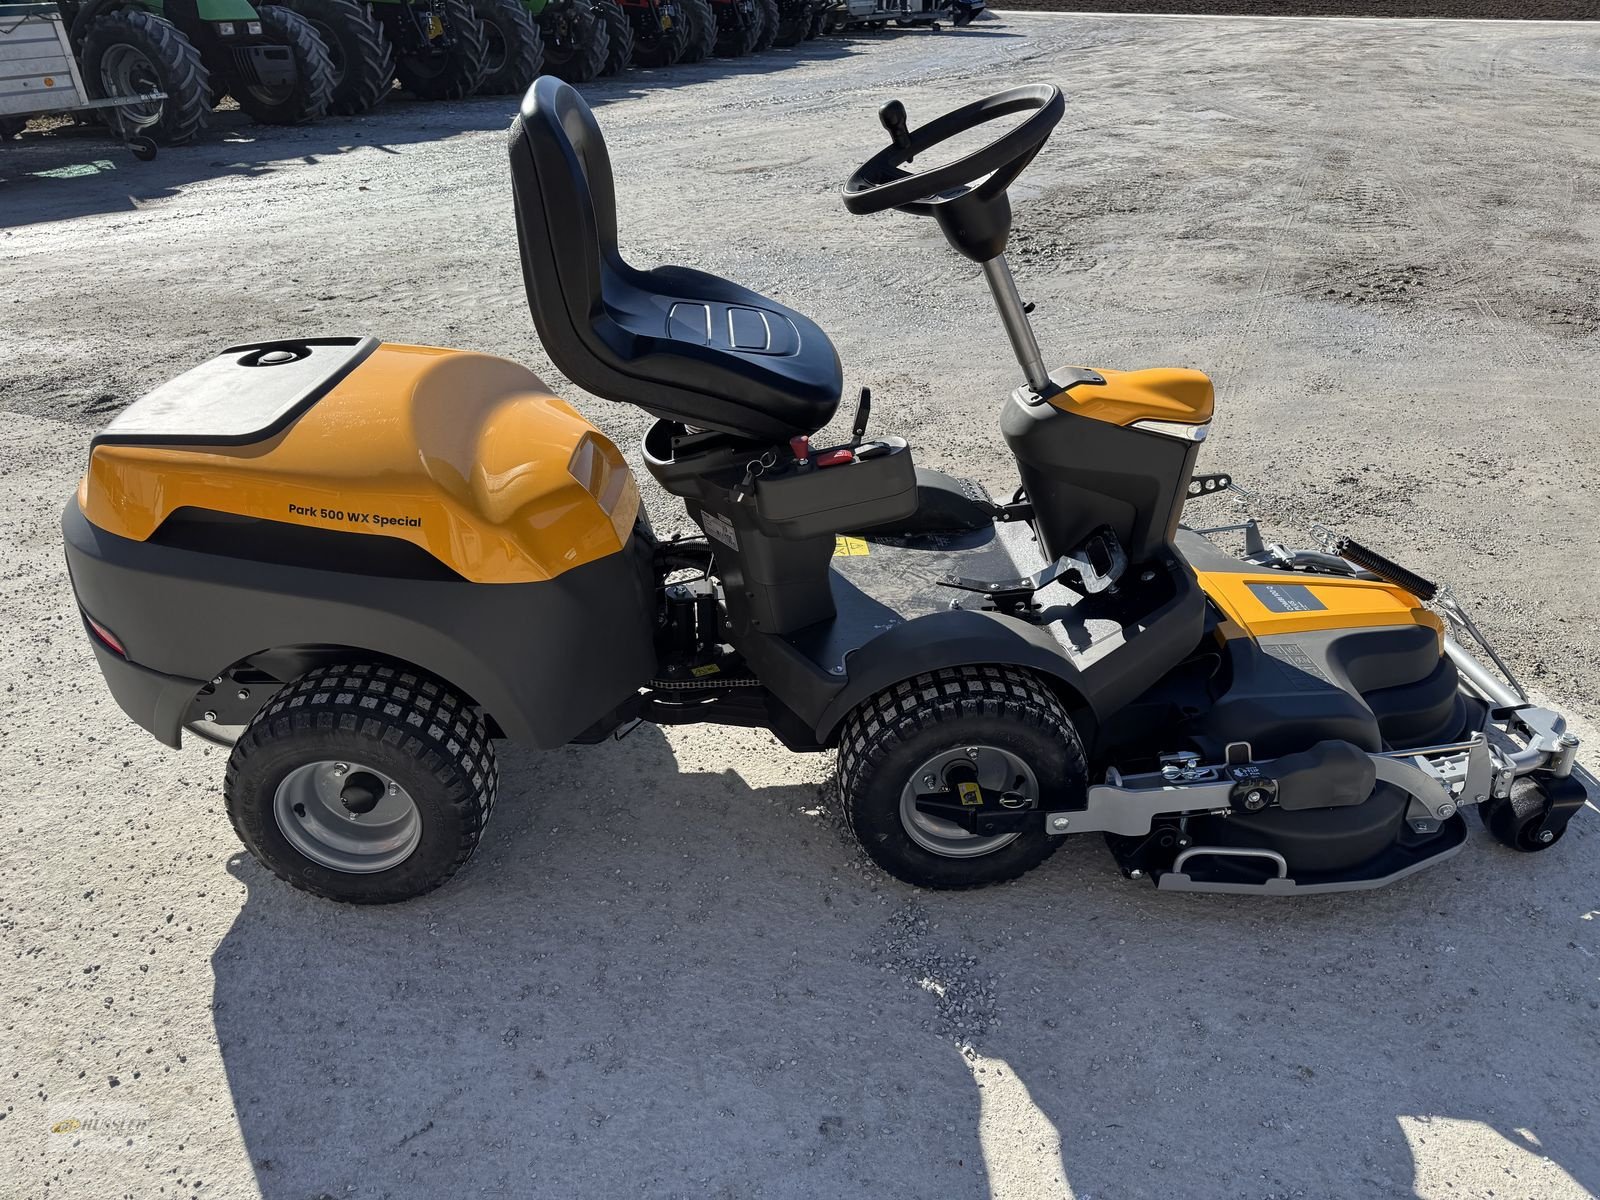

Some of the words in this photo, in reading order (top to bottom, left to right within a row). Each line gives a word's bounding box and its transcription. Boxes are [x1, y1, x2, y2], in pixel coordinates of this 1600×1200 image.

[288, 503, 317, 517] Park
[320, 508, 344, 521] 500
[347, 511, 370, 523] WX
[372, 514, 422, 528] Special
